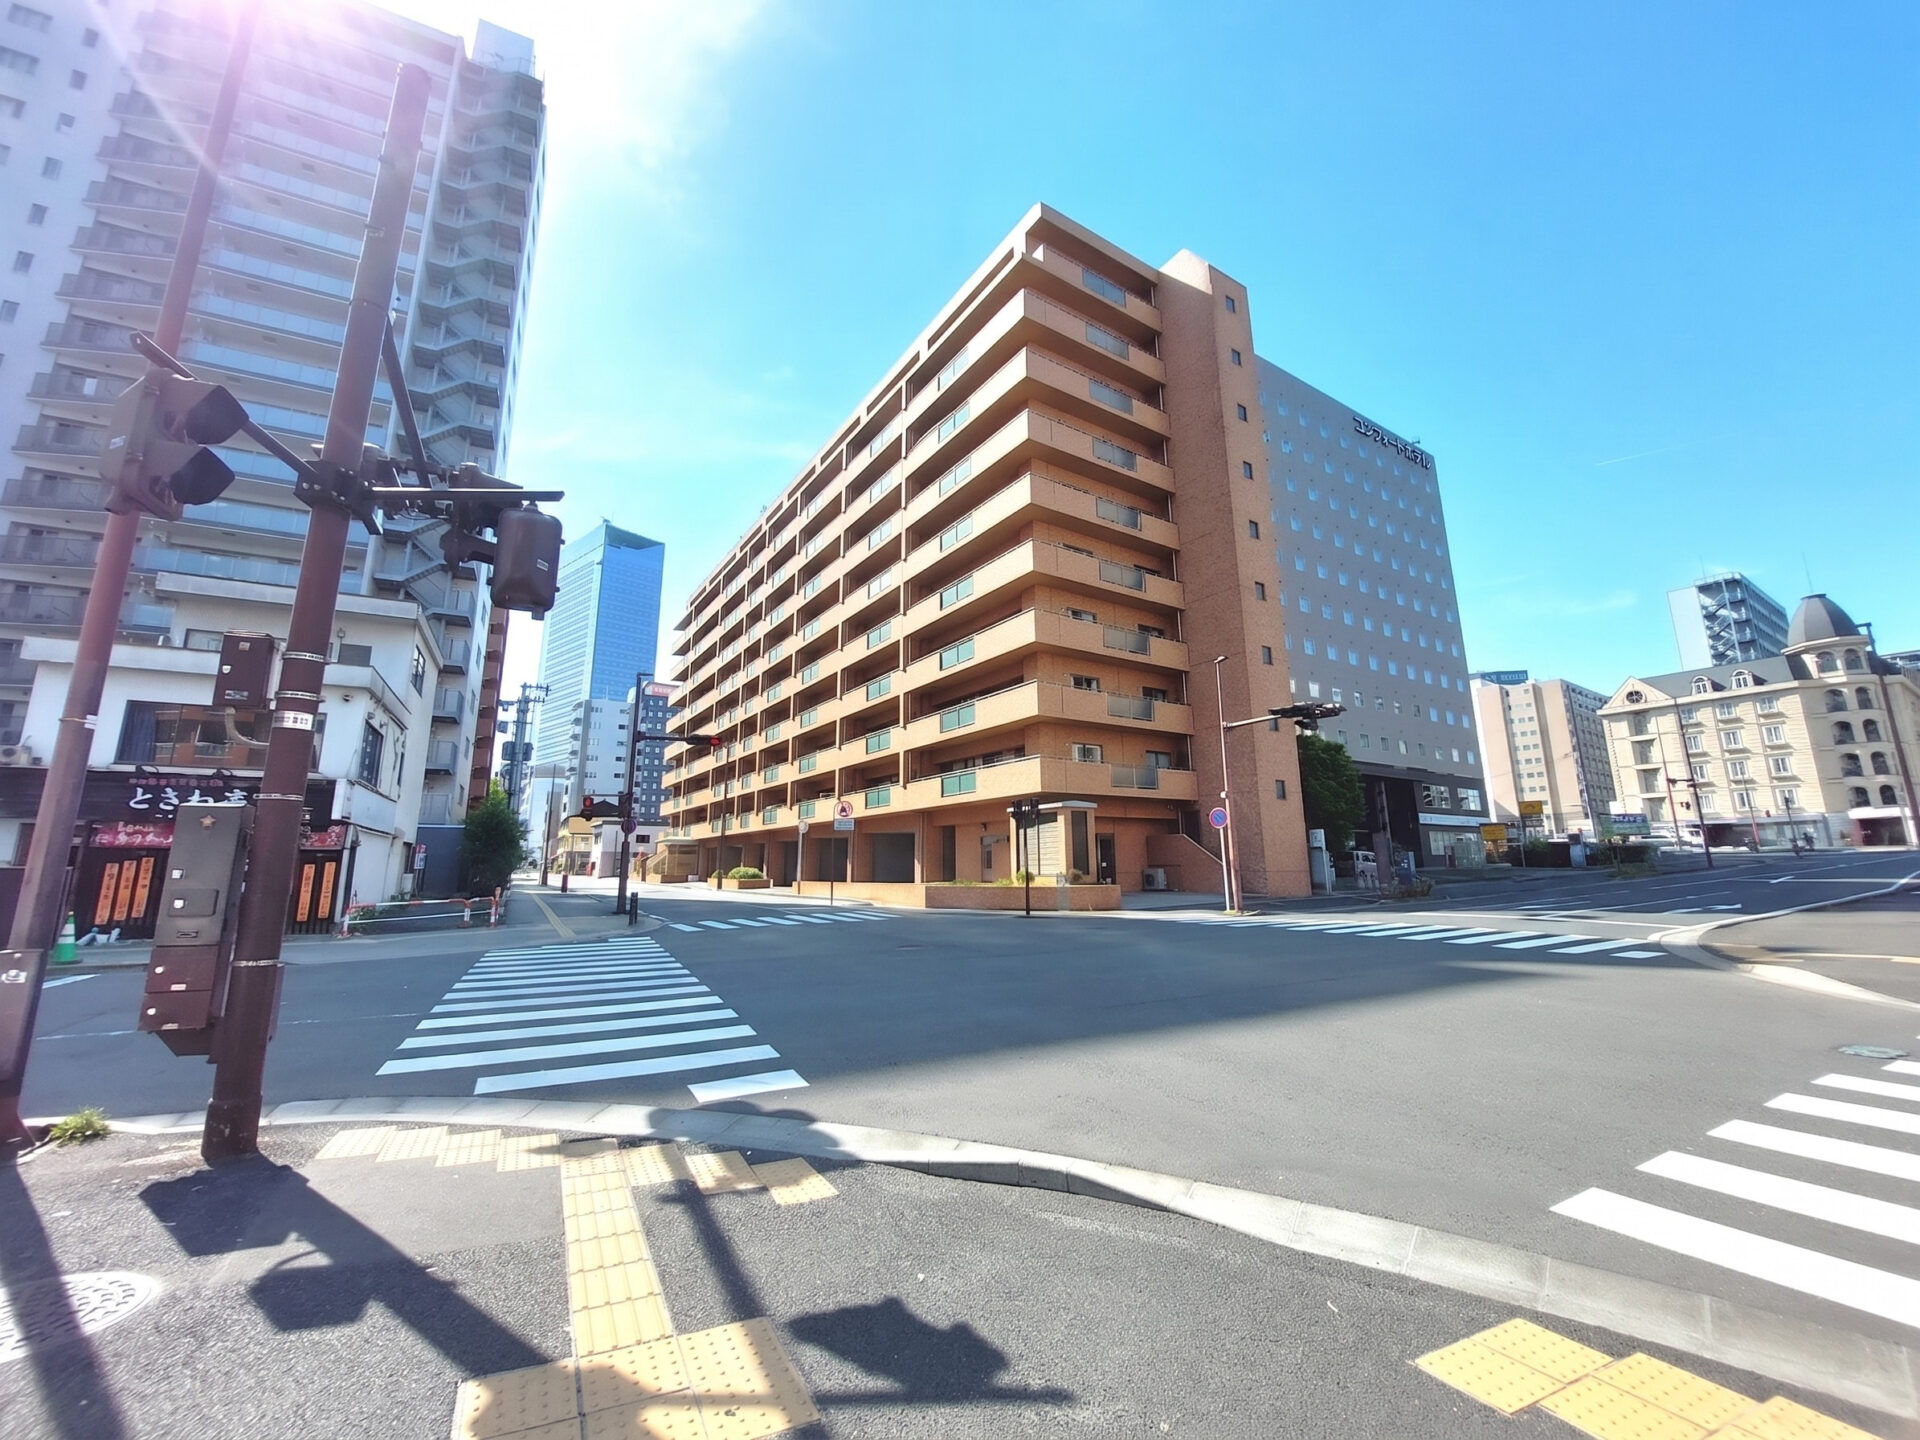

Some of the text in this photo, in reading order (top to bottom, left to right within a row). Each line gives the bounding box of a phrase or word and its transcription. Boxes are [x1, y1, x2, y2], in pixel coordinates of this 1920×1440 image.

[1353, 416, 1431, 469] コンフォートホテル
